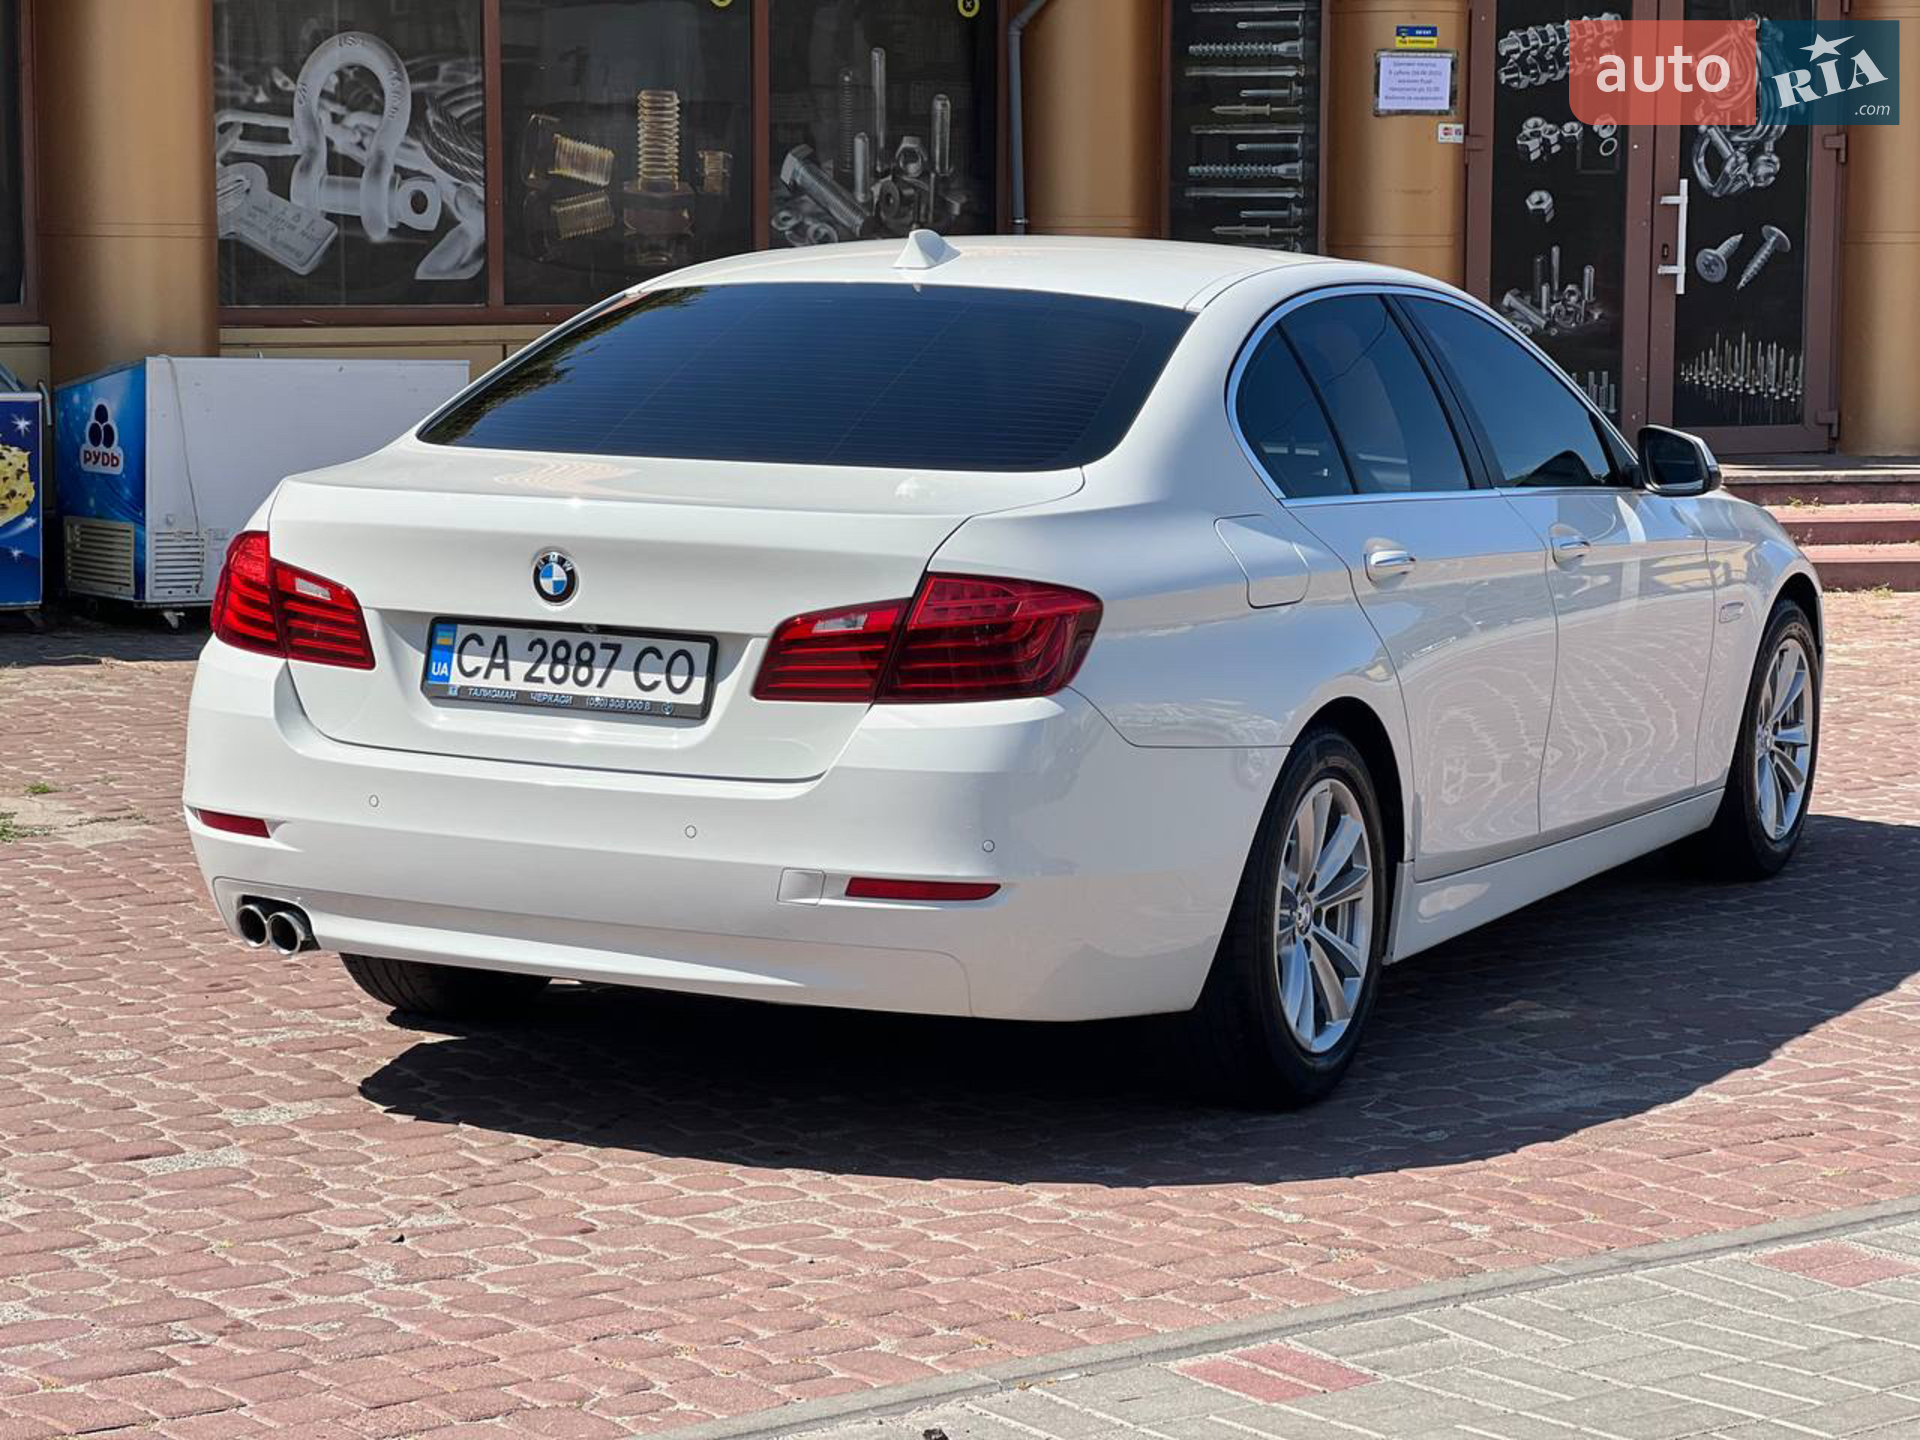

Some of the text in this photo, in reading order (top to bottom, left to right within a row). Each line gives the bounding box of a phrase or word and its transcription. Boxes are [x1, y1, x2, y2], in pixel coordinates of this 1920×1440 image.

[83, 449, 120, 468] РУДЬ
[431, 662, 449, 676] UA
[457, 633, 695, 694] CA 2887 CO
